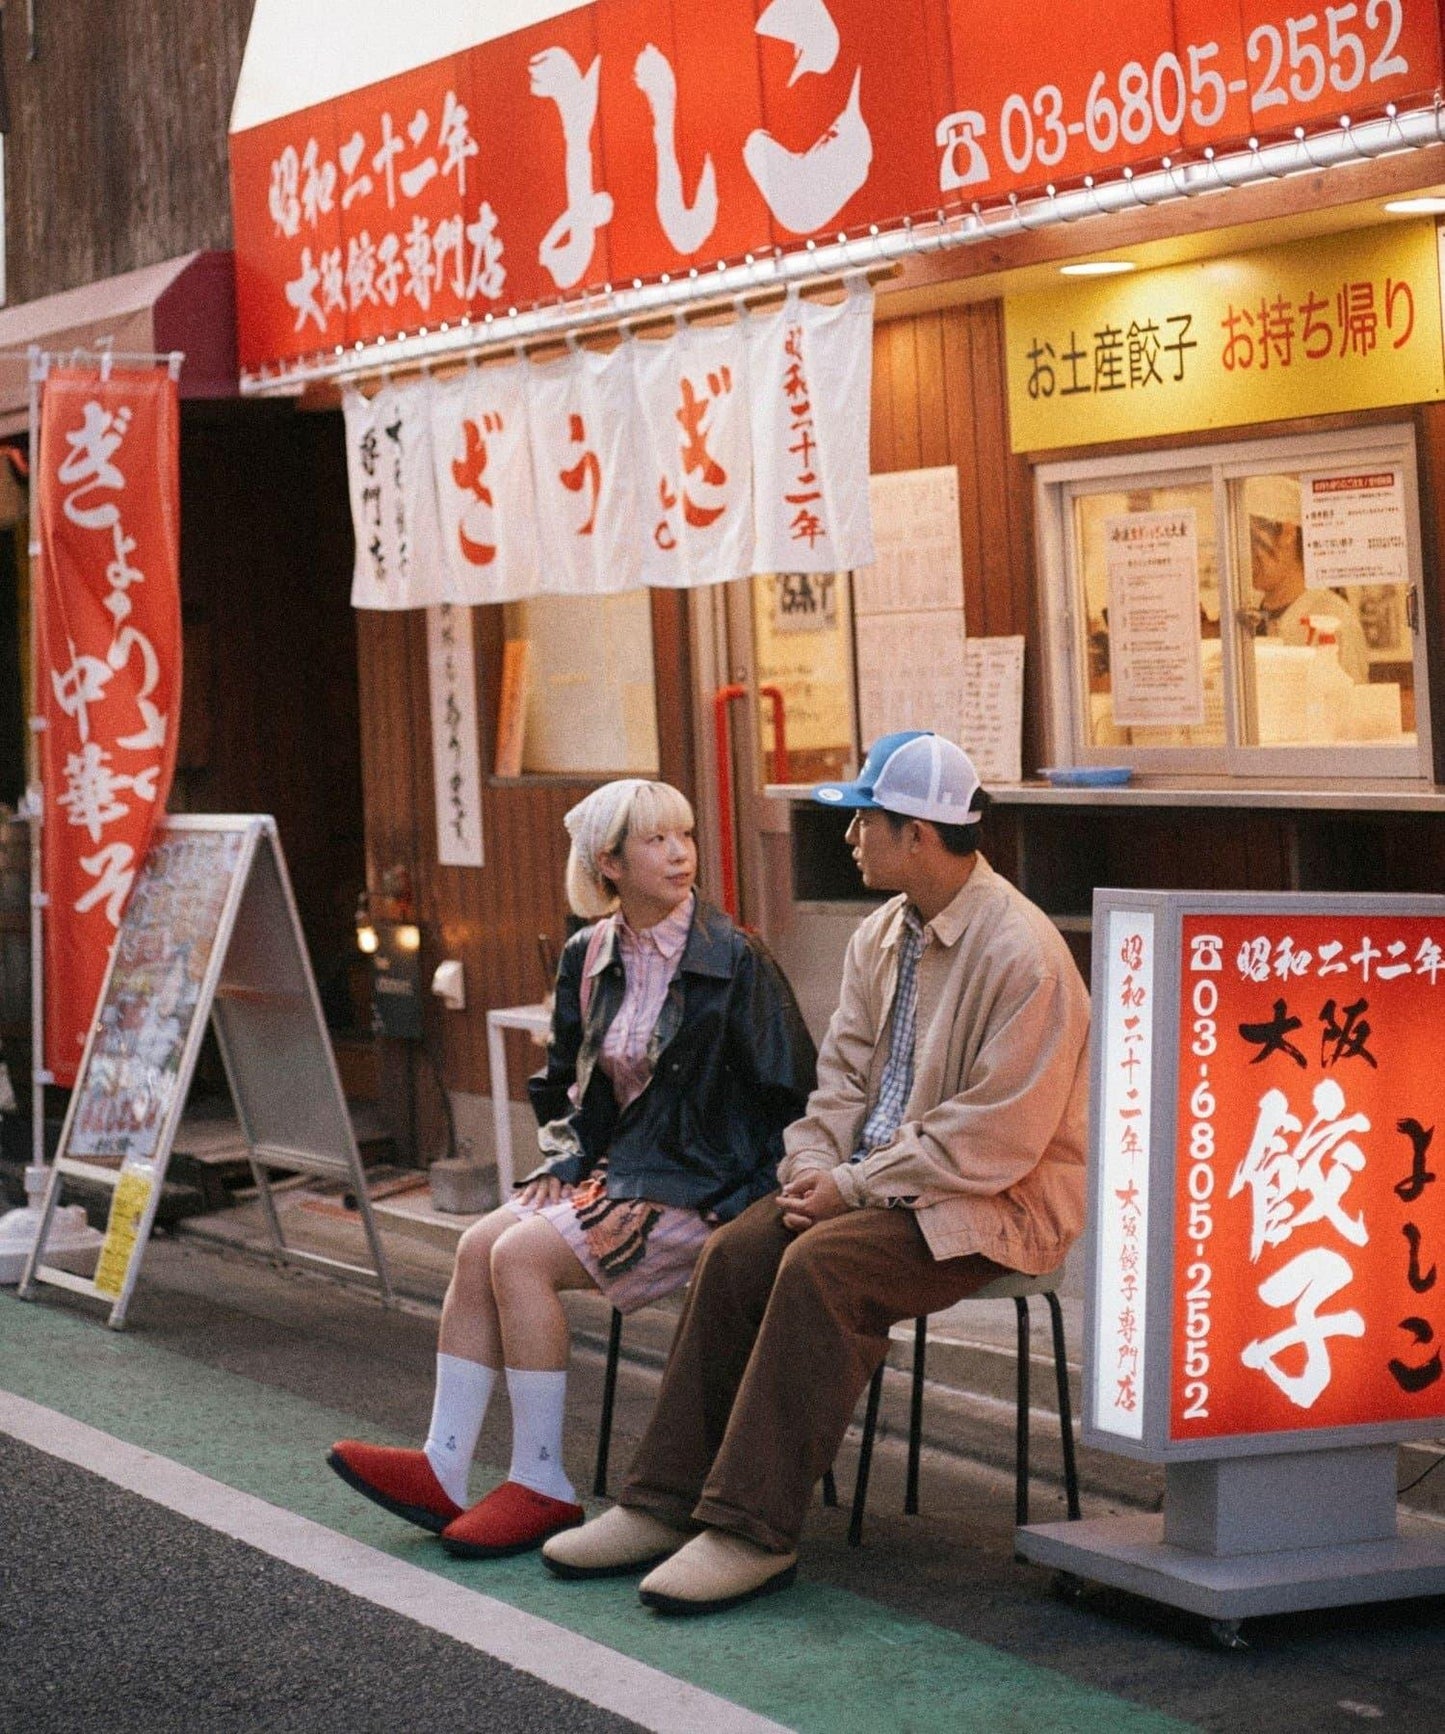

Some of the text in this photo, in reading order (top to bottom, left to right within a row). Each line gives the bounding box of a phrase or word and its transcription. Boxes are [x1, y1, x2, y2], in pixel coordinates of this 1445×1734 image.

[268, 89, 479, 238] 昭和二十二年
[527, 0, 872, 289] よしこ
[1000, 0, 1409, 174] 03-6805-2552
[285, 201, 507, 333] 大阪餃子専門店
[1026, 278, 1416, 400] お土産餃子 お持ち帰り
[52, 636, 135, 932] 中華そ
[1236, 936, 1445, 985] 昭和二十二年
[1238, 997, 1378, 1070] 大阪
[1113, 934, 1146, 1413] 昭和二十二年 大阪餃子専門店
[1184, 979, 1219, 1419] 03-6805-2552
[1229, 1078, 1371, 1410] 餃子
[1388, 1117, 1444, 1394] よしこ
